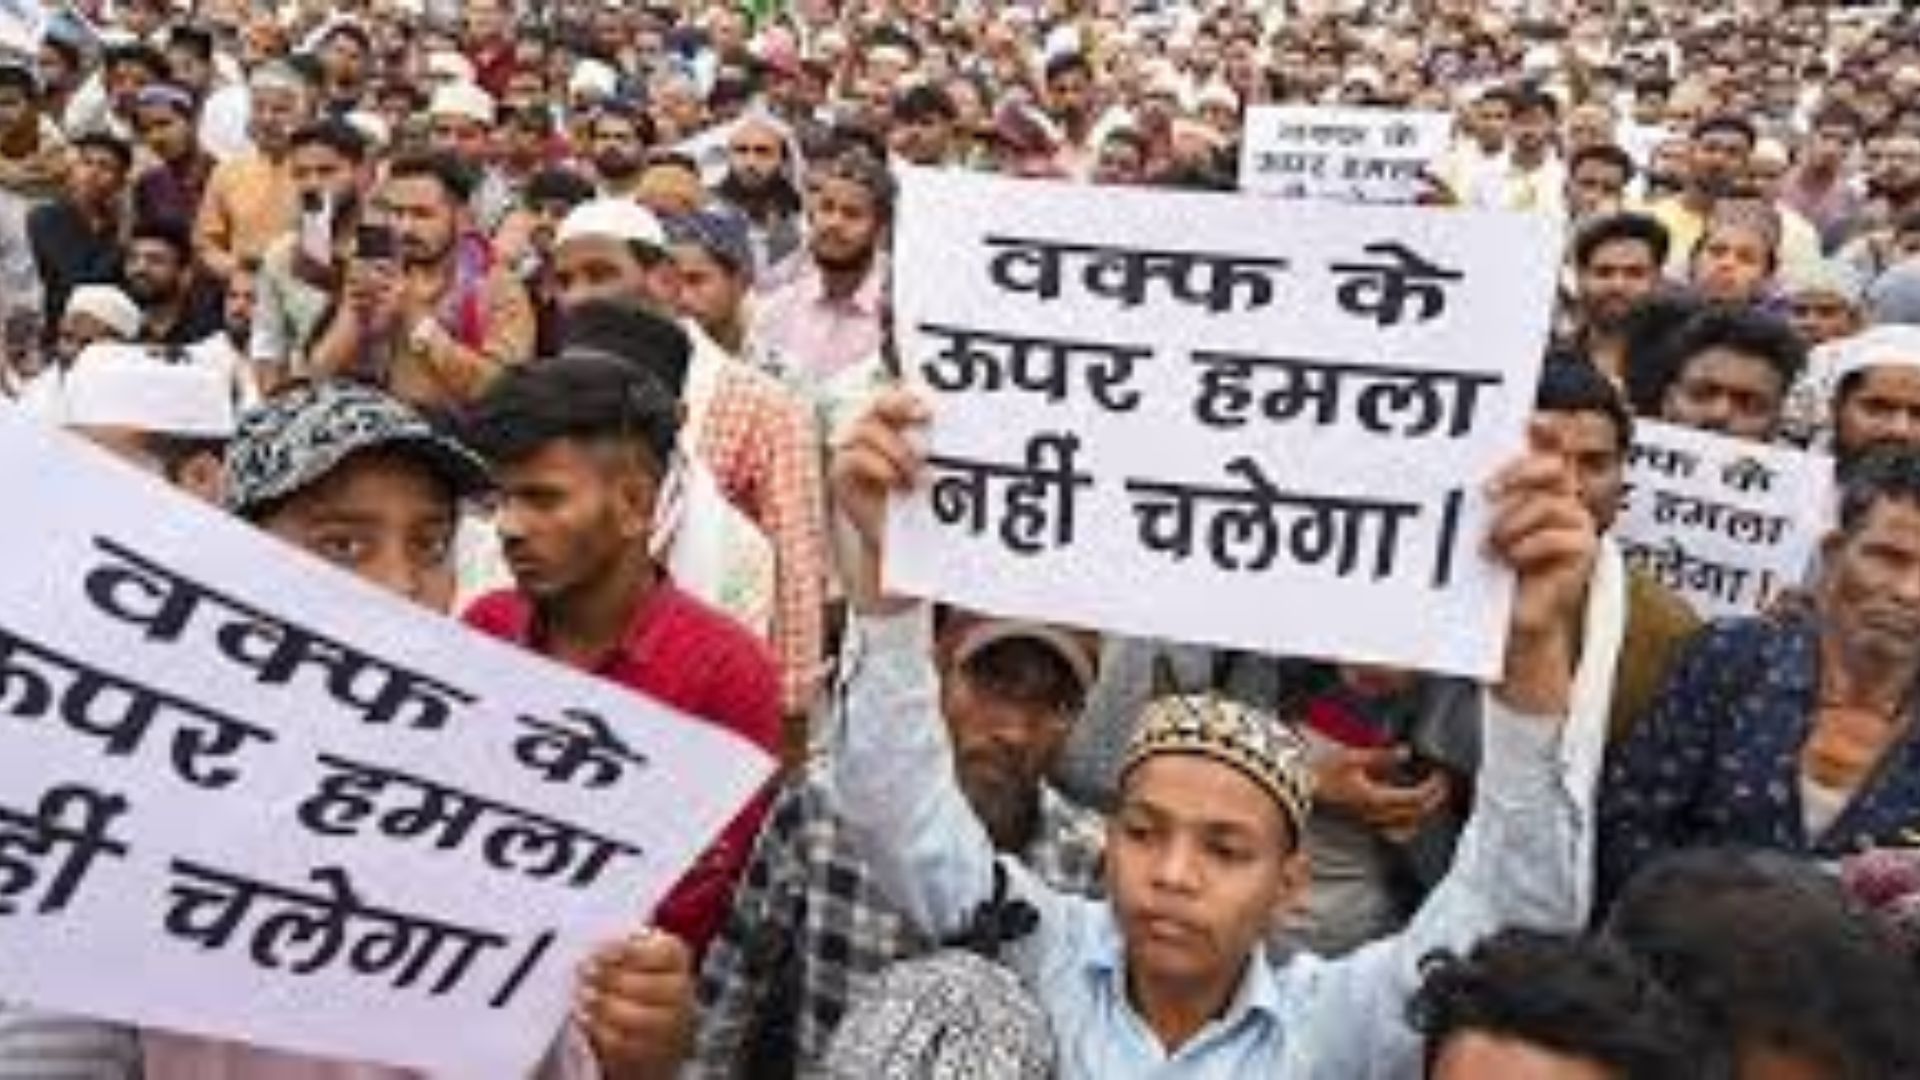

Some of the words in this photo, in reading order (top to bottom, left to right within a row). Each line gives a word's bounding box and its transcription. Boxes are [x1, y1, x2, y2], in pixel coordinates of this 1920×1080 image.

[985, 237, 1286, 312] वक्फ
[1330, 243, 1463, 326] के
[918, 324, 1153, 412] ऊपर
[1191, 351, 1502, 437] हमला
[922, 433, 1093, 554] नहीं
[85, 537, 477, 729] वक्फ
[514, 710, 646, 787] के
[297, 754, 642, 886] हमला
